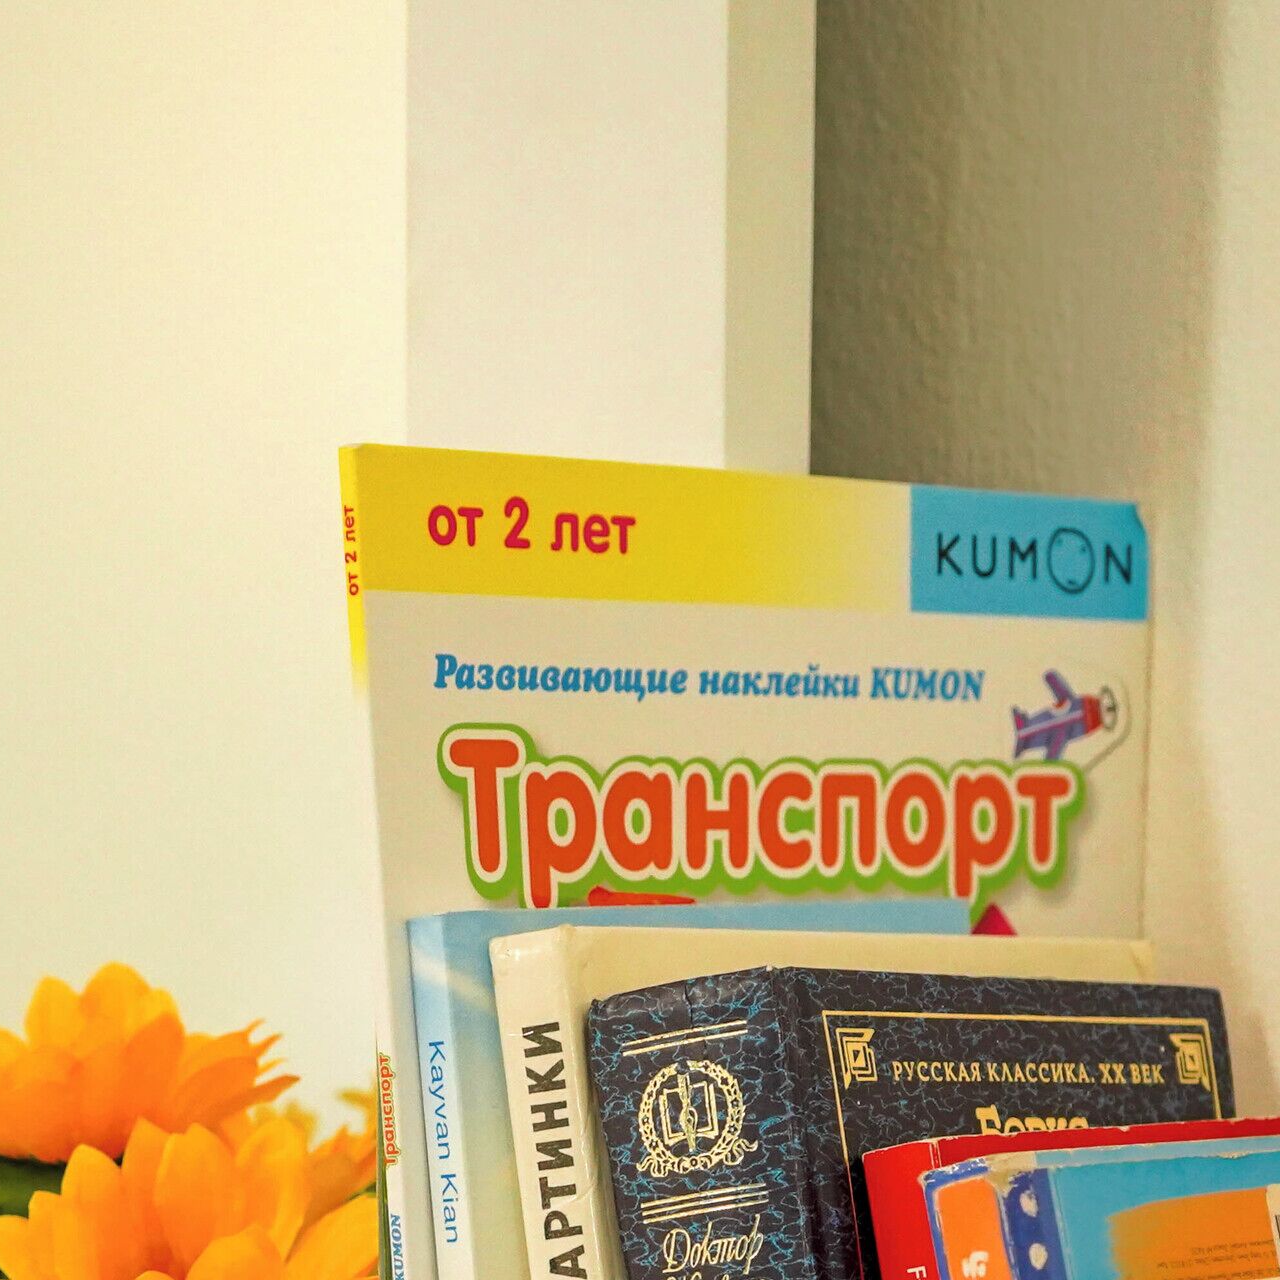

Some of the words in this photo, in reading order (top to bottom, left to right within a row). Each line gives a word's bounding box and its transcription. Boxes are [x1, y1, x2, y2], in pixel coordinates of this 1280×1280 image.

[343, 504, 356, 542] лет
[427, 506, 484, 548] от
[503, 497, 531, 550] 2
[550, 510, 636, 555] лет
[344, 551, 357, 564] 2
[348, 571, 360, 596] от
[936, 526, 1135, 594] KUMON
[433, 654, 688, 701] Развивающие
[698, 663, 860, 700] наклейки
[870, 667, 986, 701] KUMON
[442, 733, 1080, 909] Транспорт
[893, 1061, 981, 1083] РУССКАЯ
[987, 1062, 1096, 1084] КЛАССИКА.
[1131, 1064, 1165, 1084] ВЕК
[427, 1040, 451, 1159] Kayvan
[440, 1174, 458, 1244] Kian
[663, 1214, 764, 1275] Доктор
